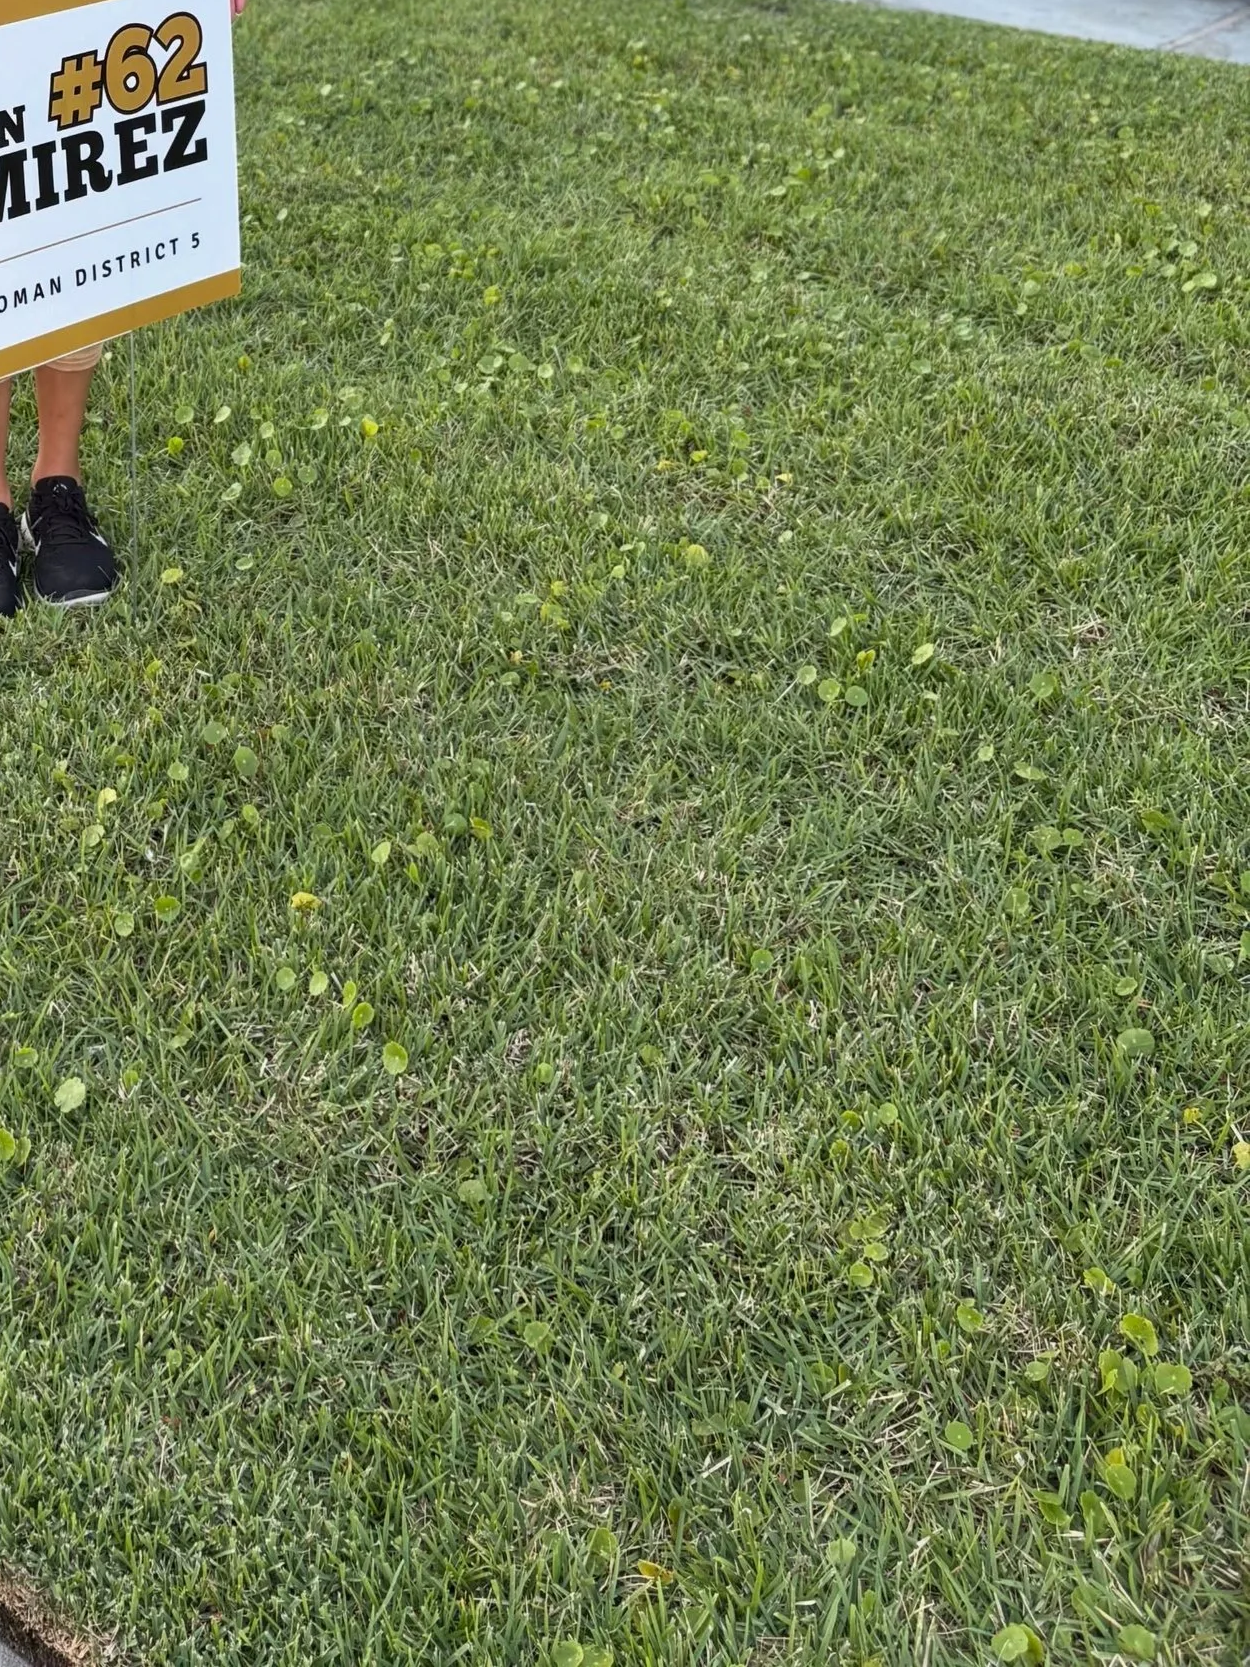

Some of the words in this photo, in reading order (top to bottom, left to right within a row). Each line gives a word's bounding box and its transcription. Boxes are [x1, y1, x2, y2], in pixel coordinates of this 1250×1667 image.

[48, 12, 207, 130] #62
[75, 238, 178, 286] DISTRICT
[191, 232, 200, 248] 5
